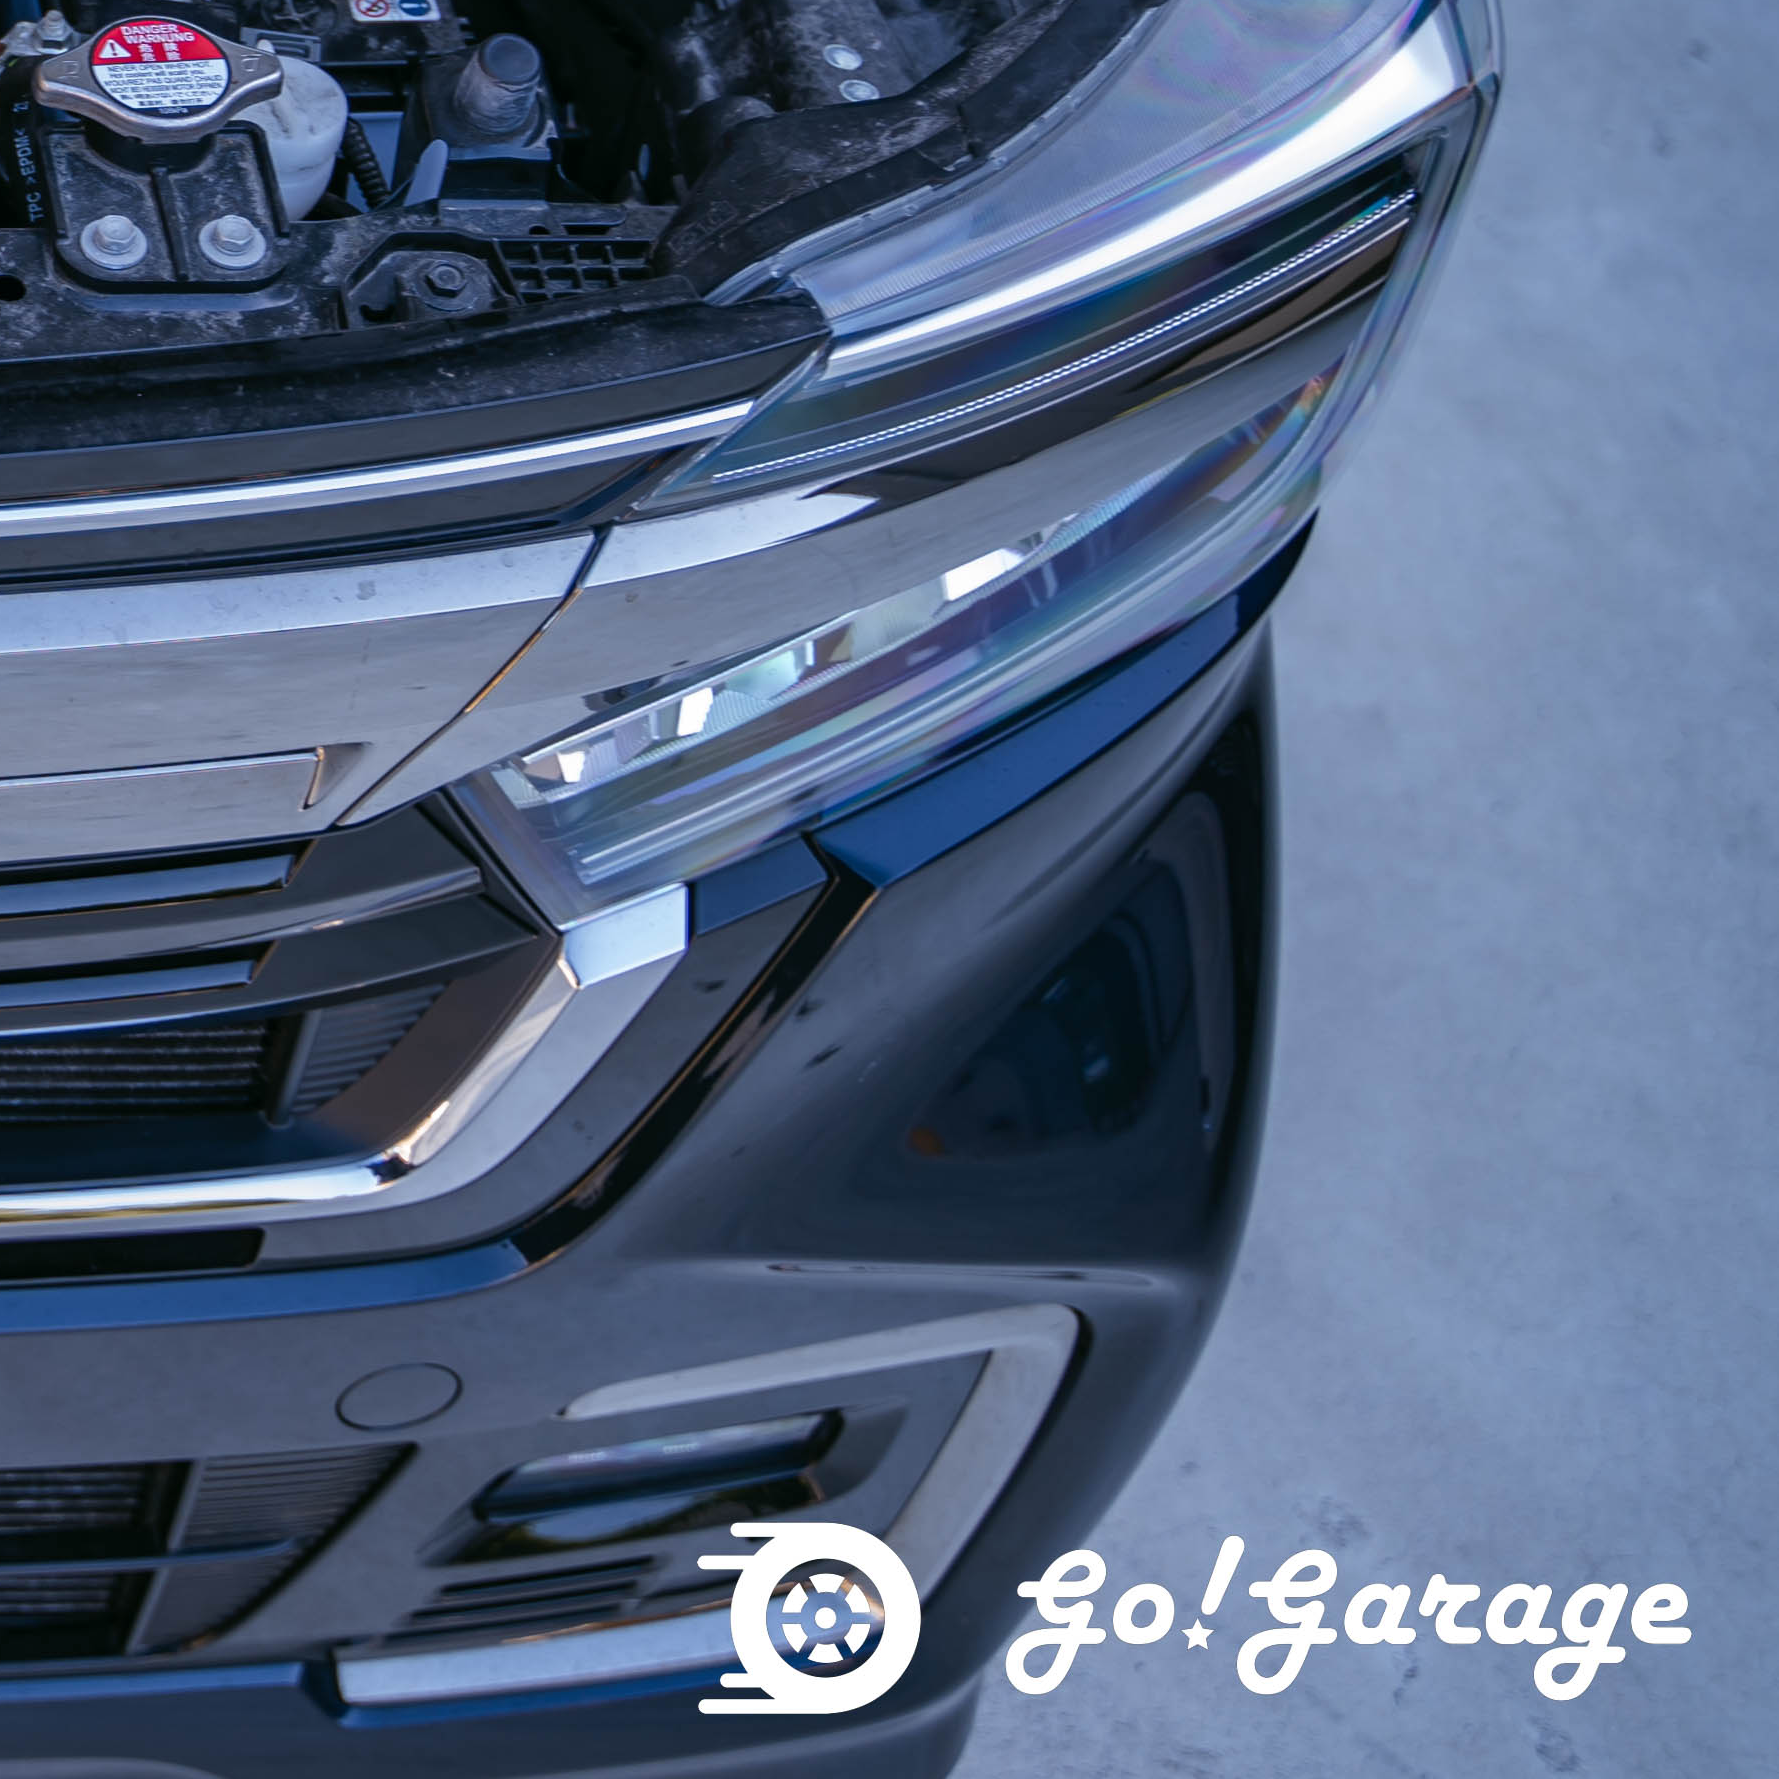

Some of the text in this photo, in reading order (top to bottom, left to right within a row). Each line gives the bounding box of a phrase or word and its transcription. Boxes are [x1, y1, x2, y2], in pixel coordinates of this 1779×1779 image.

[120, 24, 179, 35] DANGER
[123, 32, 196, 44] WARNUNG
[25, 191, 46, 223] TPC
